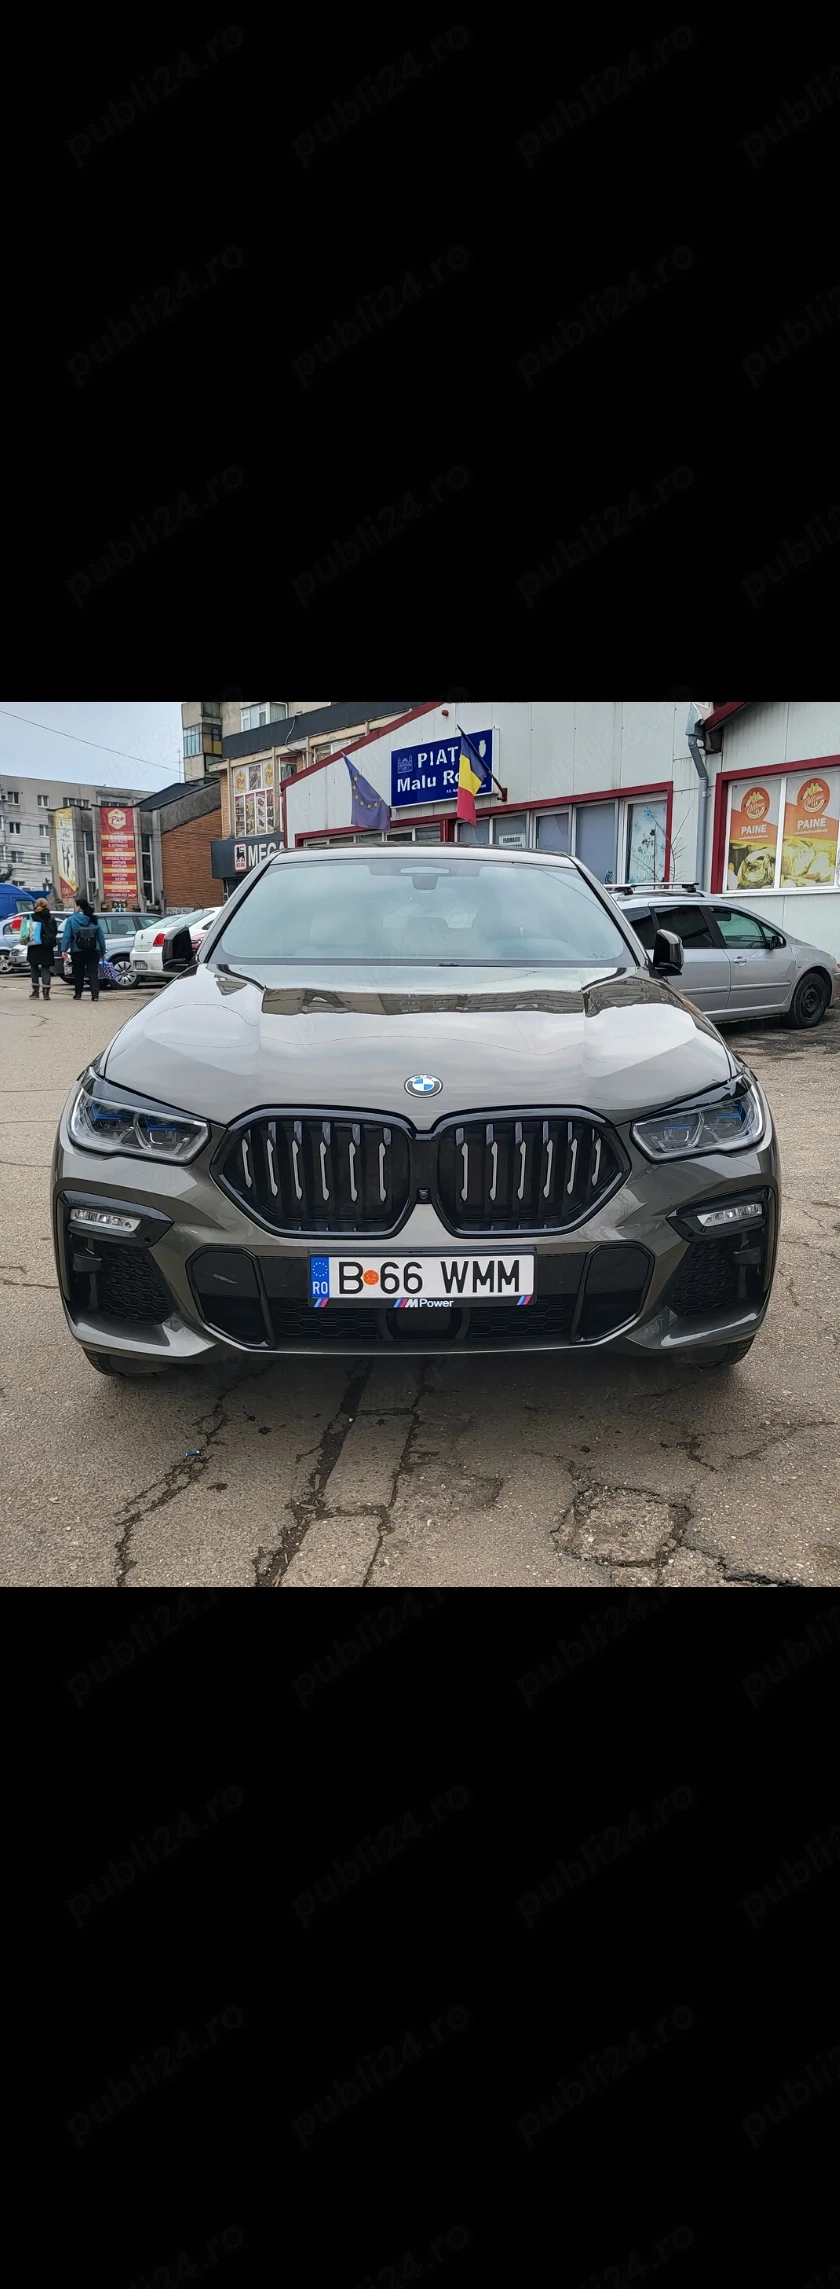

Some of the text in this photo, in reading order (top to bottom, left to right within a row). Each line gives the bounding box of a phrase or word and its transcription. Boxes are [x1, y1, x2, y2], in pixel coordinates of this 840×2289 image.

[417, 746, 460, 768] PIAȚ
[397, 774, 436, 792] Malu
[741, 824, 767, 835] PAINE
[797, 818, 827, 829] PAINE
[313, 1260, 520, 1295] RO B 66 WMM
